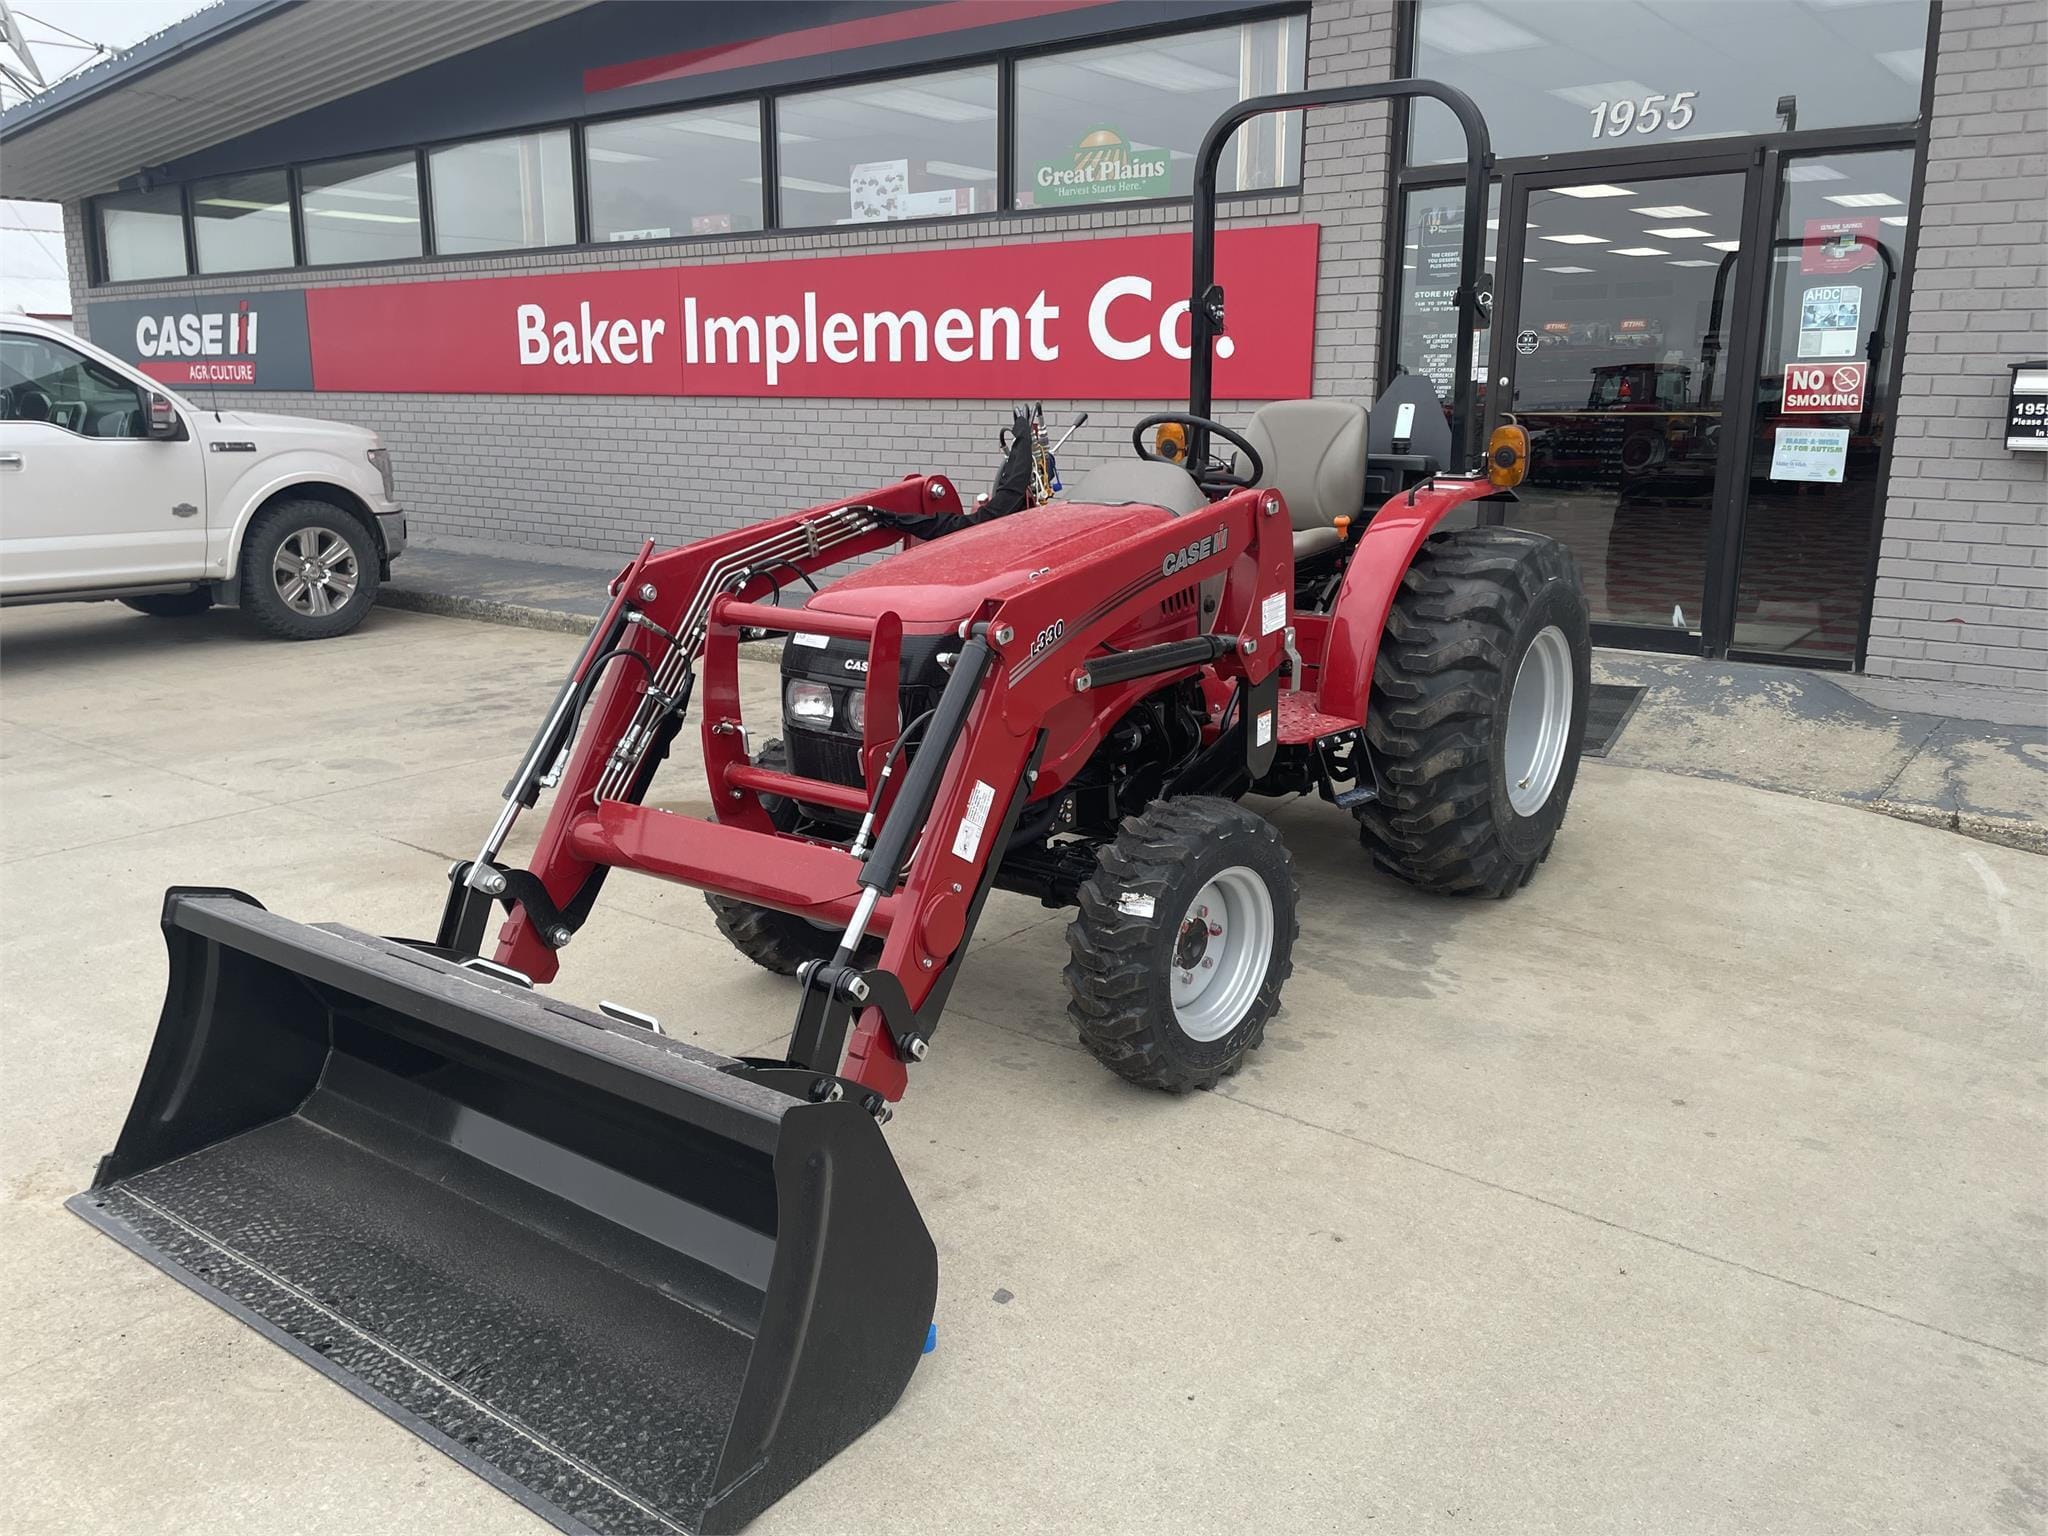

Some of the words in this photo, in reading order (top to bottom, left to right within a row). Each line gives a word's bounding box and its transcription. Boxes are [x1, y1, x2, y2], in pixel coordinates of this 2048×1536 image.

[1590, 91, 1698, 139] 1955
[1037, 164, 1096, 187] Great
[1099, 158, 1166, 181] Plains
[1091, 182, 1117, 194] Starts
[1414, 290, 1441, 299] STORE
[1806, 288, 1840, 301] AHDC
[517, 300, 666, 366] Baker
[684, 288, 1060, 386] Implement
[1087, 275, 1235, 361] Co.
[1622, 320, 1646, 329] STIHL
[136, 312, 223, 357] CASE
[1791, 369, 1825, 390] NO
[1786, 393, 1859, 407] SMOKING
[2015, 402, 2048, 416] 195
[2012, 417, 2042, 426] Please
[2035, 428, 2045, 437] In
[1162, 535, 1212, 577] CASE
[1030, 618, 1065, 659] L330
[844, 659, 869, 673] CAS
